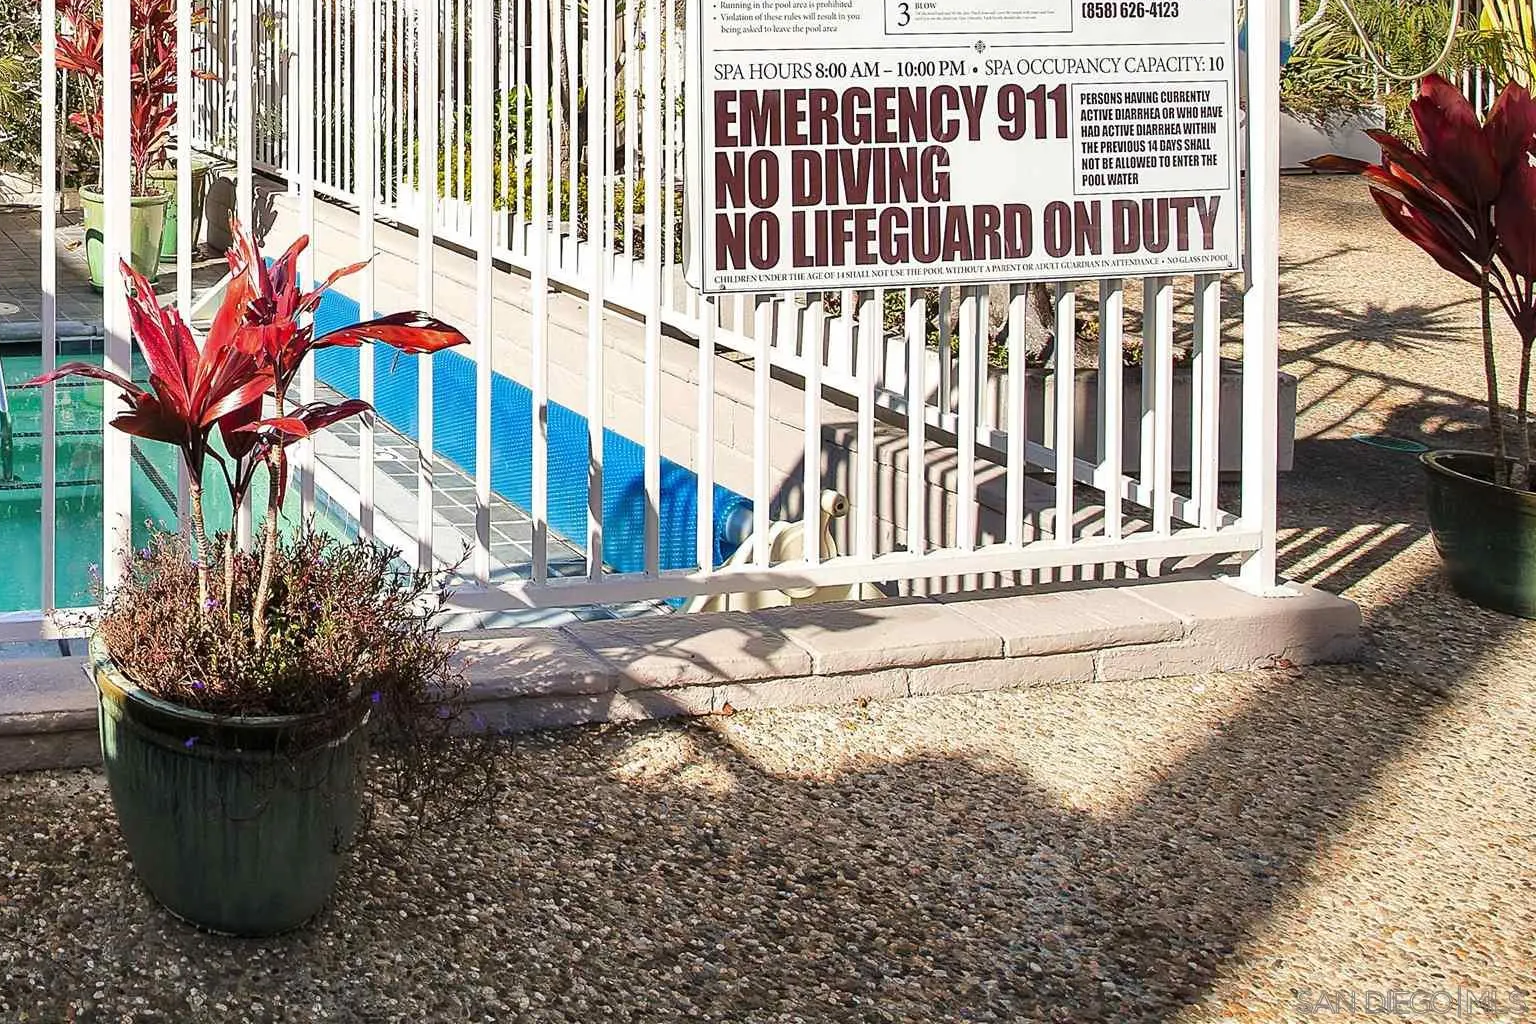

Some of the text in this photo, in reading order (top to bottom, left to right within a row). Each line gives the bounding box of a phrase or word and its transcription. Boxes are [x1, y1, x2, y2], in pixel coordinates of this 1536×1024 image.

[721, 2, 751, 10] Running
[775, 1, 790, 10] pool
[816, 1, 852, 10] prohibited
[1082, 2, 1179, 18] (858) 626-4123
[721, 13, 753, 21] Violation
[755, 13, 762, 21] of
[764, 13, 782, 21] these
[846, 14, 860, 22] you
[898, 3, 910, 26] 3
[721, 25, 741, 35] being
[805, 25, 821, 34] pool
[715, 60, 965, 80] SPA HOURS 8:00 AM 10:00 PM
[986, 57, 1223, 75] SPA OCCUPANCY CAPACITY: 10
[1081, 91, 1210, 104] PERSONS HAVING CURRENTLY
[715, 83, 1068, 147] EMERGENCY 911
[1081, 106, 1223, 121] ACTIVE DIARRHEA OR WHO HAVE
[1081, 122, 1216, 137] HAD ACTIVE DIARRHEA WITHIN
[1082, 139, 1210, 153] THE PREVIOUS 14 DAYS SHALL
[1082, 154, 1217, 170] NOT BE ALLOWED TO ENTER THE
[715, 146, 950, 209] NO DIVING
[1082, 173, 1138, 186] POOL WATER
[715, 196, 1221, 270] NO LIFEGUARD ON DUTY
[924, 267, 944, 275] POOL
[946, 266, 983, 274] WITHOUT
[992, 264, 1020, 272] PARENT
[1061, 260, 1100, 269] GUARDIAN
[1113, 258, 1158, 266] ATTENDANCE
